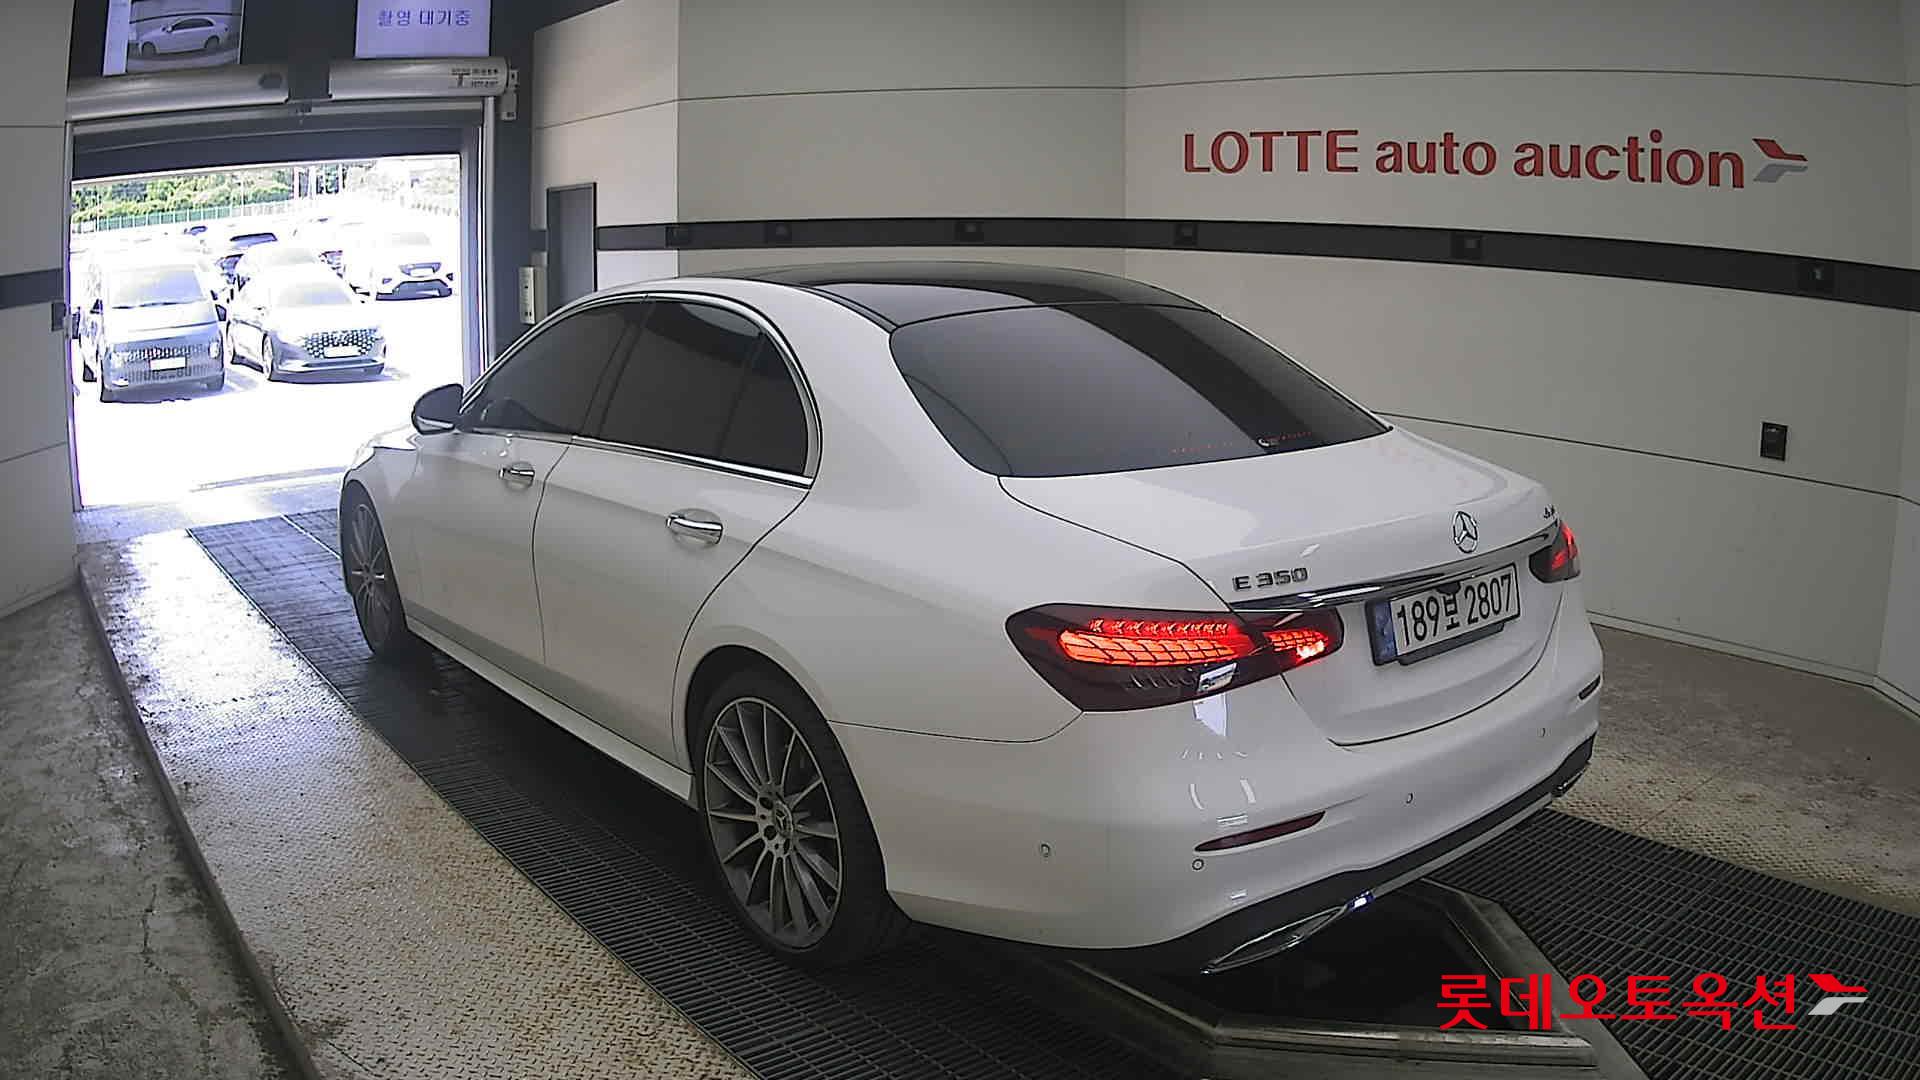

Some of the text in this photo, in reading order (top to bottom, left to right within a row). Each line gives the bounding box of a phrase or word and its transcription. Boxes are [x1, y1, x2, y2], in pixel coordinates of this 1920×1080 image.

[419, 9, 472, 26] 대기중
[1184, 130, 1745, 189] LOTTE auto auction
[1232, 567, 1308, 592] E 350
[1464, 573, 1512, 625] 2807
